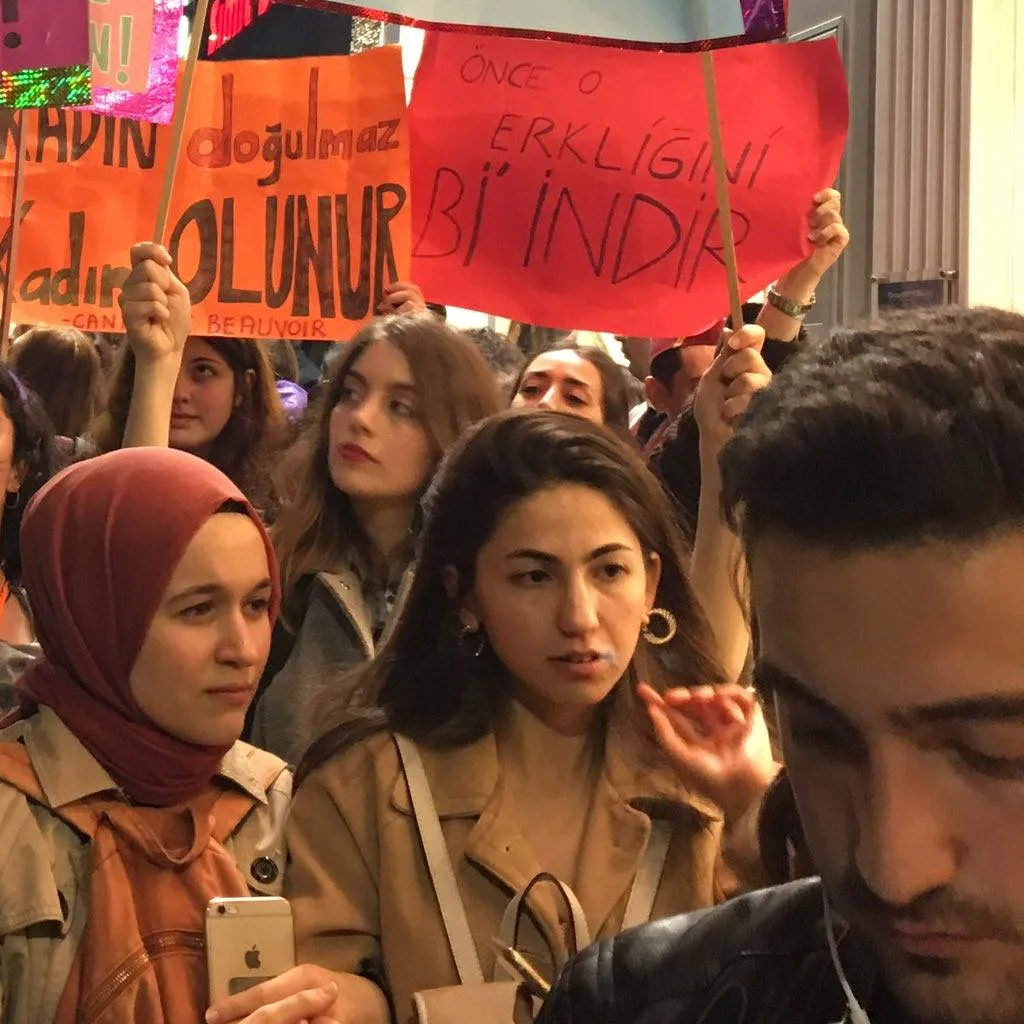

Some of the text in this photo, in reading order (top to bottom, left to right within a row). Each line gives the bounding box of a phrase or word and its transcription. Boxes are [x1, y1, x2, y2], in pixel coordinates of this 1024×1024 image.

[460, 42, 603, 95] ÖNCE O
[187, 67, 400, 187] doğulmaz
[168, 182, 407, 321] OLUNUR
[206, 314, 327, 338] BEAUVOIR
